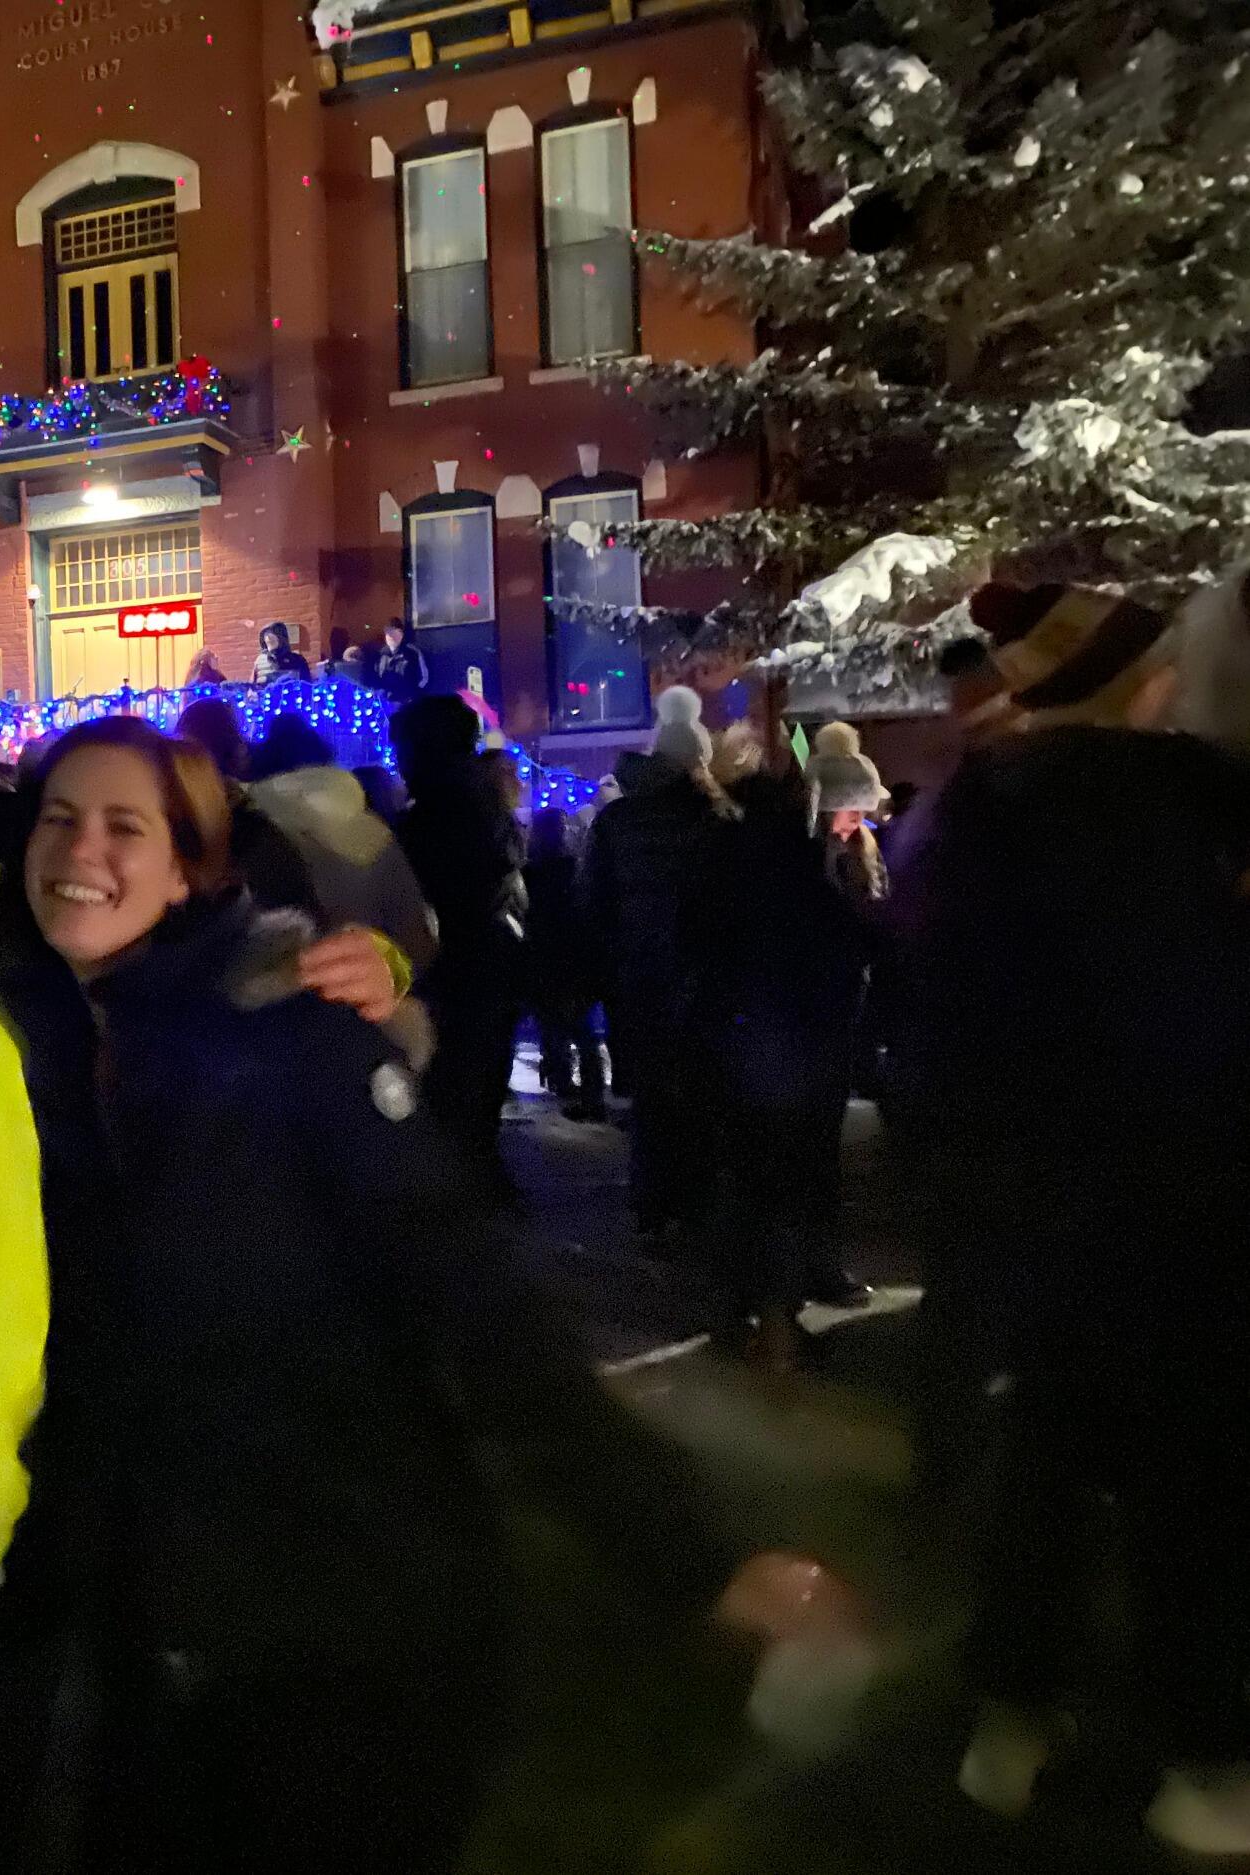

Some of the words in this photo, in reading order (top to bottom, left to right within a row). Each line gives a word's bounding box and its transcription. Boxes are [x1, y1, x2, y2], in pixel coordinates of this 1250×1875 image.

[17, 0, 116, 39] MIGUEL
[20, 37, 90, 70] COURT
[110, 13, 182, 46] HOUSE
[81, 58, 121, 82] 1887
